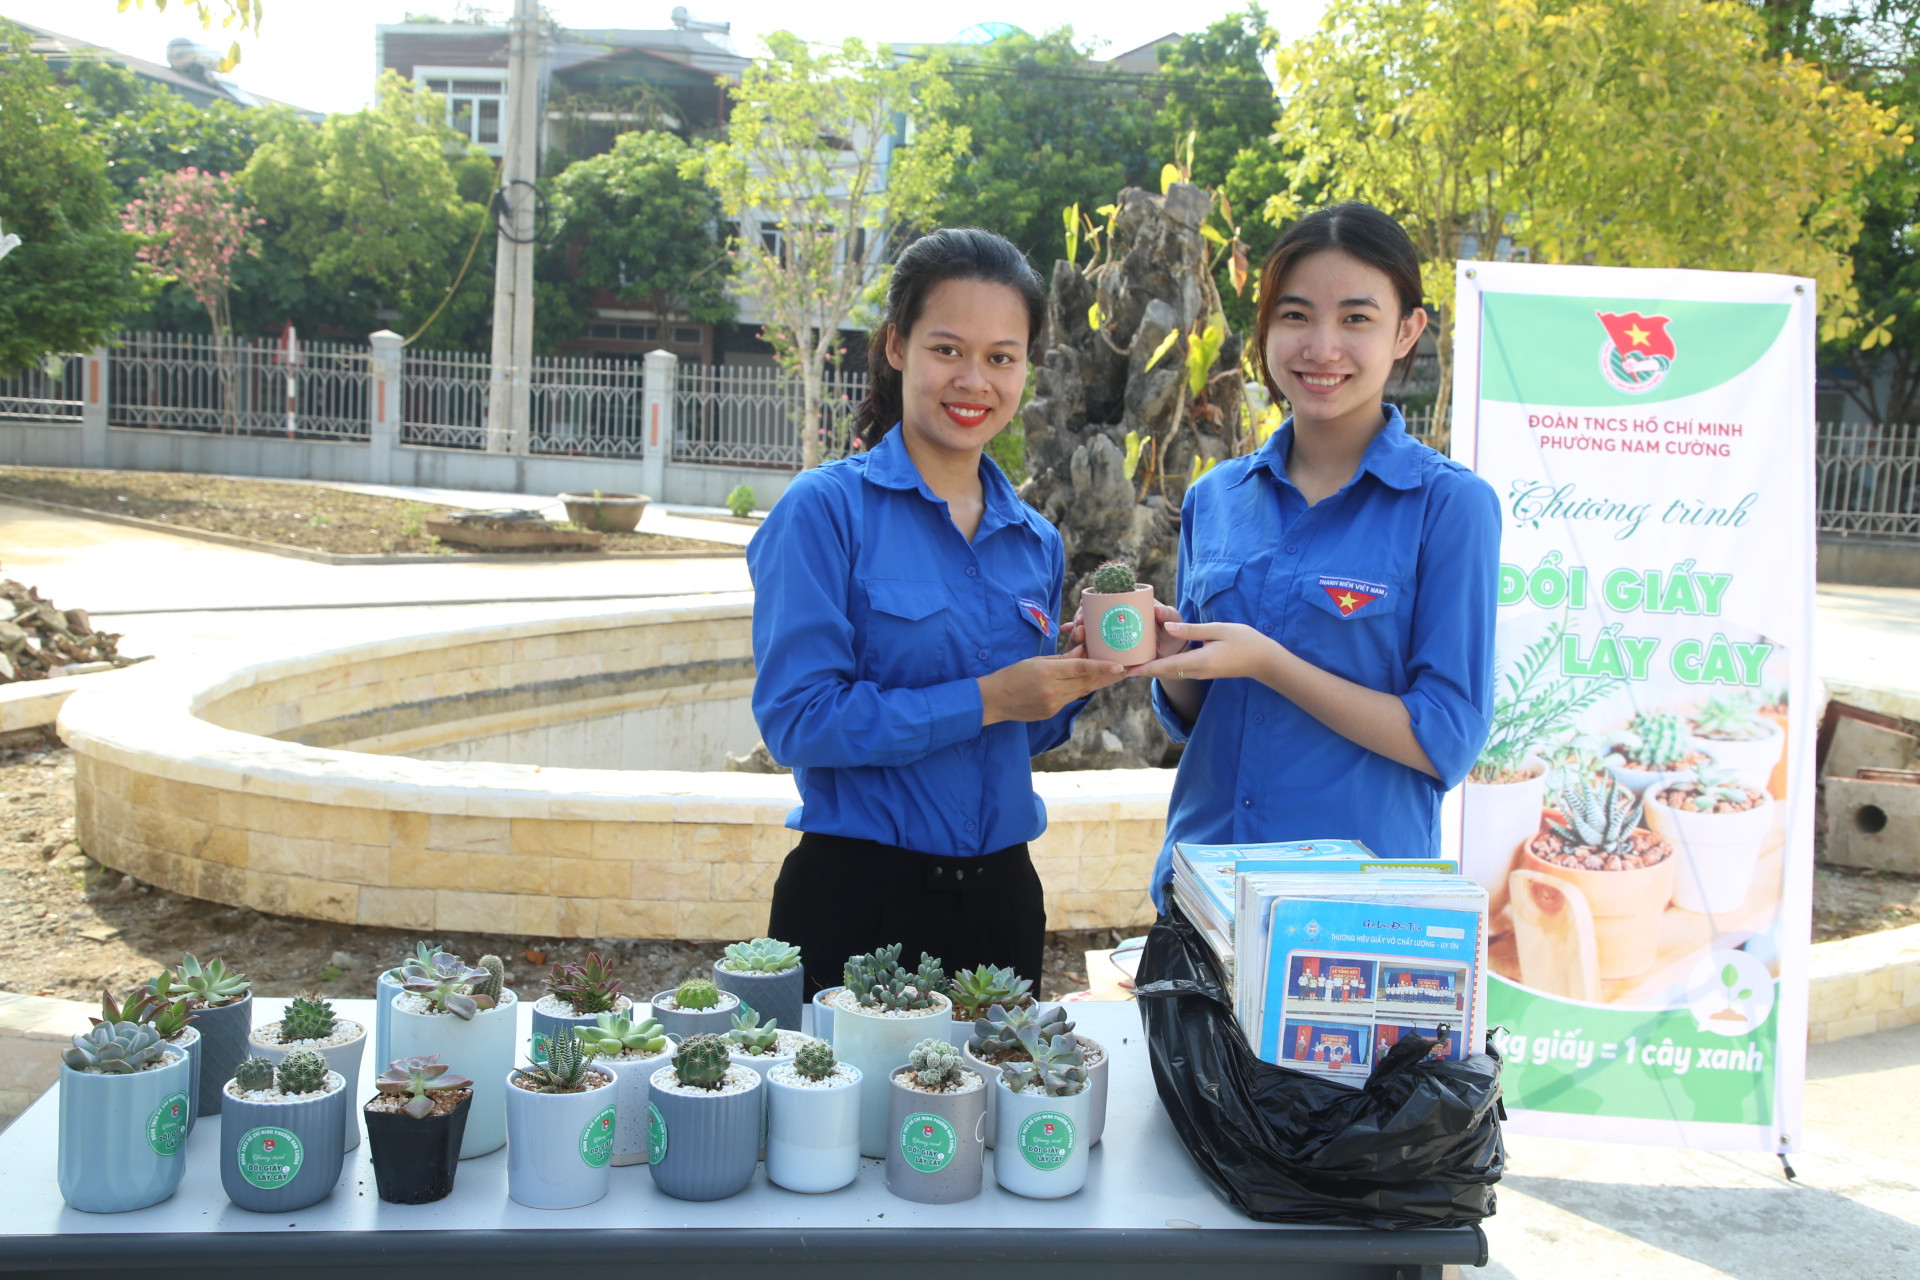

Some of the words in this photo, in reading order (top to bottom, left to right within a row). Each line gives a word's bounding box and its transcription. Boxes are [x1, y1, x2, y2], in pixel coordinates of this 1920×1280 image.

[1528, 413, 1578, 430] ĐOÀN
[1584, 416, 1628, 432] TNCS
[1664, 418, 1694, 434] CHÍ
[1698, 422, 1743, 437] MINH
[1540, 434, 1616, 452] PHƯỜNG
[1621, 440, 1660, 454] NAM
[1665, 440, 1731, 457] CƯỜNG
[1509, 479, 1651, 541] Chương
[1662, 492, 1759, 528] trình
[1603, 559, 1733, 616] GIẤY
[1560, 623, 1660, 681] LẤY
[1670, 633, 1774, 687] CÂY
[1532, 1028, 1595, 1069] giấy
[1601, 1042, 1618, 1059] =
[1624, 1036, 1636, 1064] 1
[1641, 1037, 1692, 1075] cây
[1696, 1042, 1763, 1072] xanh
